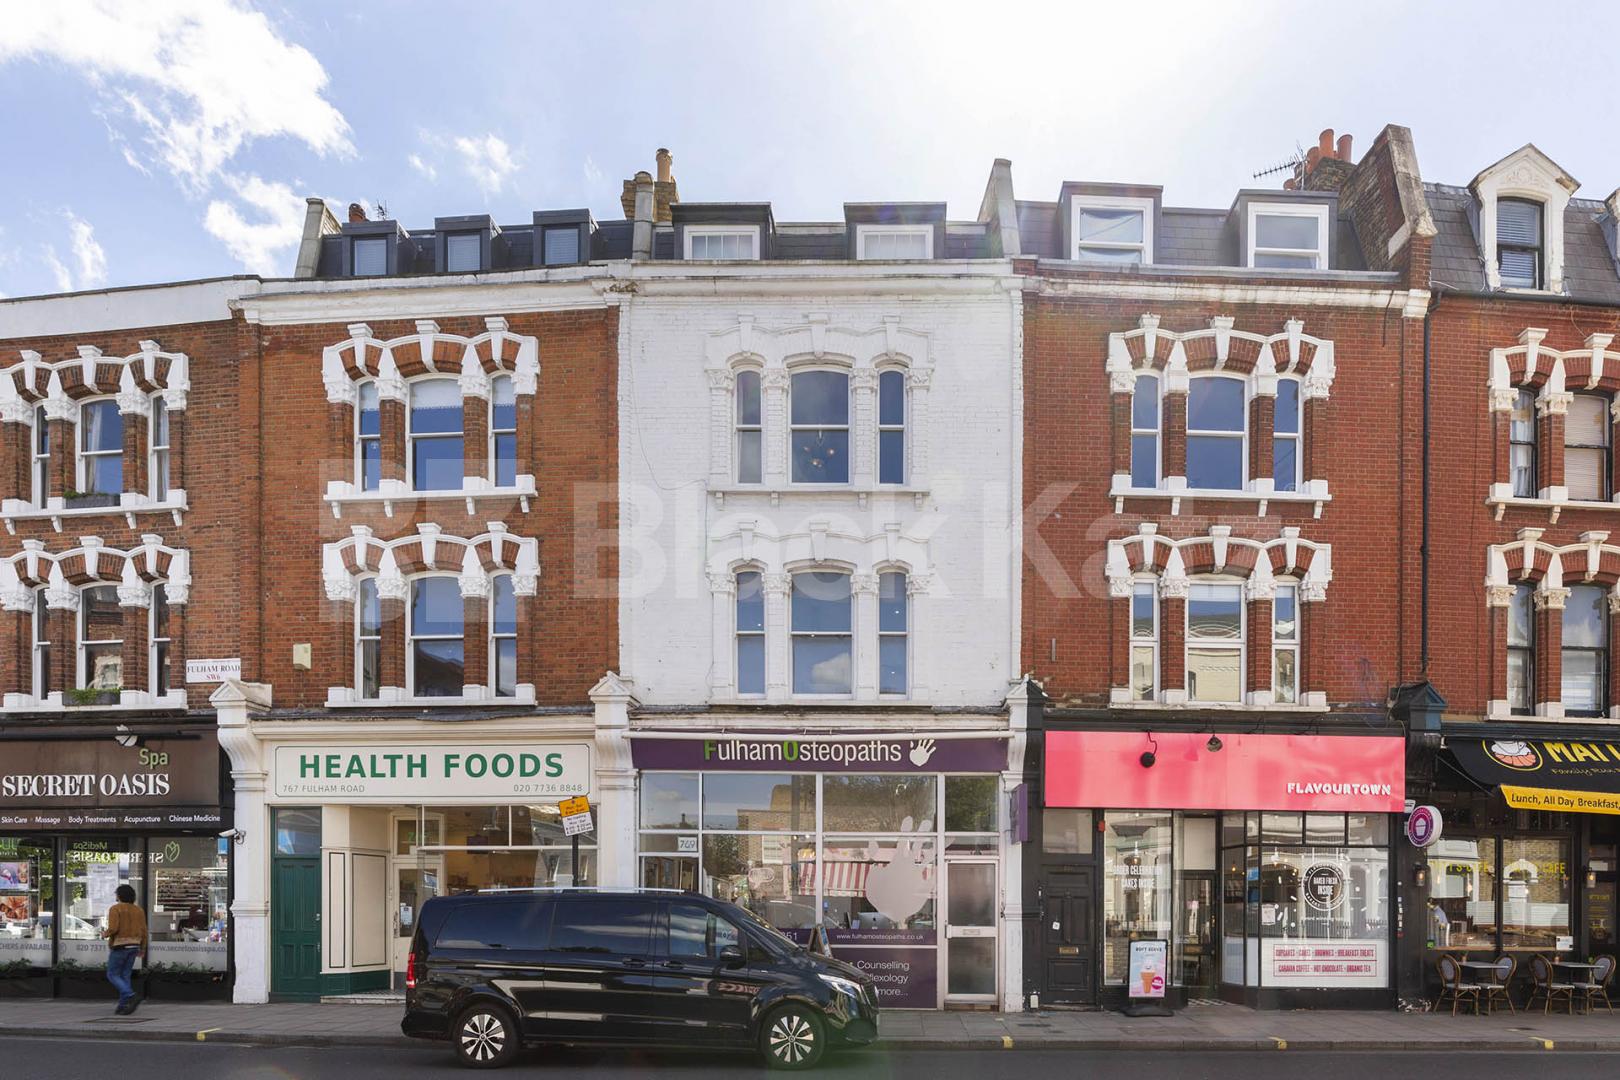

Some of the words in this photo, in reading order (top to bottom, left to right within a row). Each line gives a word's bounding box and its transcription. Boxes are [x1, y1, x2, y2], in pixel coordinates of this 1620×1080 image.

[187, 665, 218, 673] FULHAM
[220, 664, 241, 672] ROAD
[138, 748, 169, 769] Spa
[704, 739, 902, 766] FulhamOsteopaths
[300, 754, 428, 779] HEALTH
[444, 753, 565, 778] FOODS
[1, 774, 96, 798] SECRET
[100, 773, 171, 797] OASIS
[282, 784, 299, 793] 767
[302, 784, 338, 793] FULHAM
[340, 784, 366, 793] ROAD
[513, 783, 531, 793] 020
[534, 783, 558, 793] 7736
[560, 783, 583, 793] 8848
[1286, 781, 1392, 797] FLAVOURTOWN
[1511, 793, 1541, 805] Lunch,
[1543, 795, 1555, 805] All
[1557, 796, 1575, 808] Day
[1, 816, 14, 824] Skin
[14, 816, 28, 824] Care
[34, 816, 61, 825] Massage
[68, 815, 84, 825] Body
[84, 815, 117, 823] Treatments
[123, 815, 161, 825] Acupuncture
[168, 814, 193, 823] Chinese
[193, 814, 221, 822] Medicine
[679, 839, 696, 849] 769
[1317, 885, 1333, 895] INSIDE
[856, 960, 910, 972] Counselling
